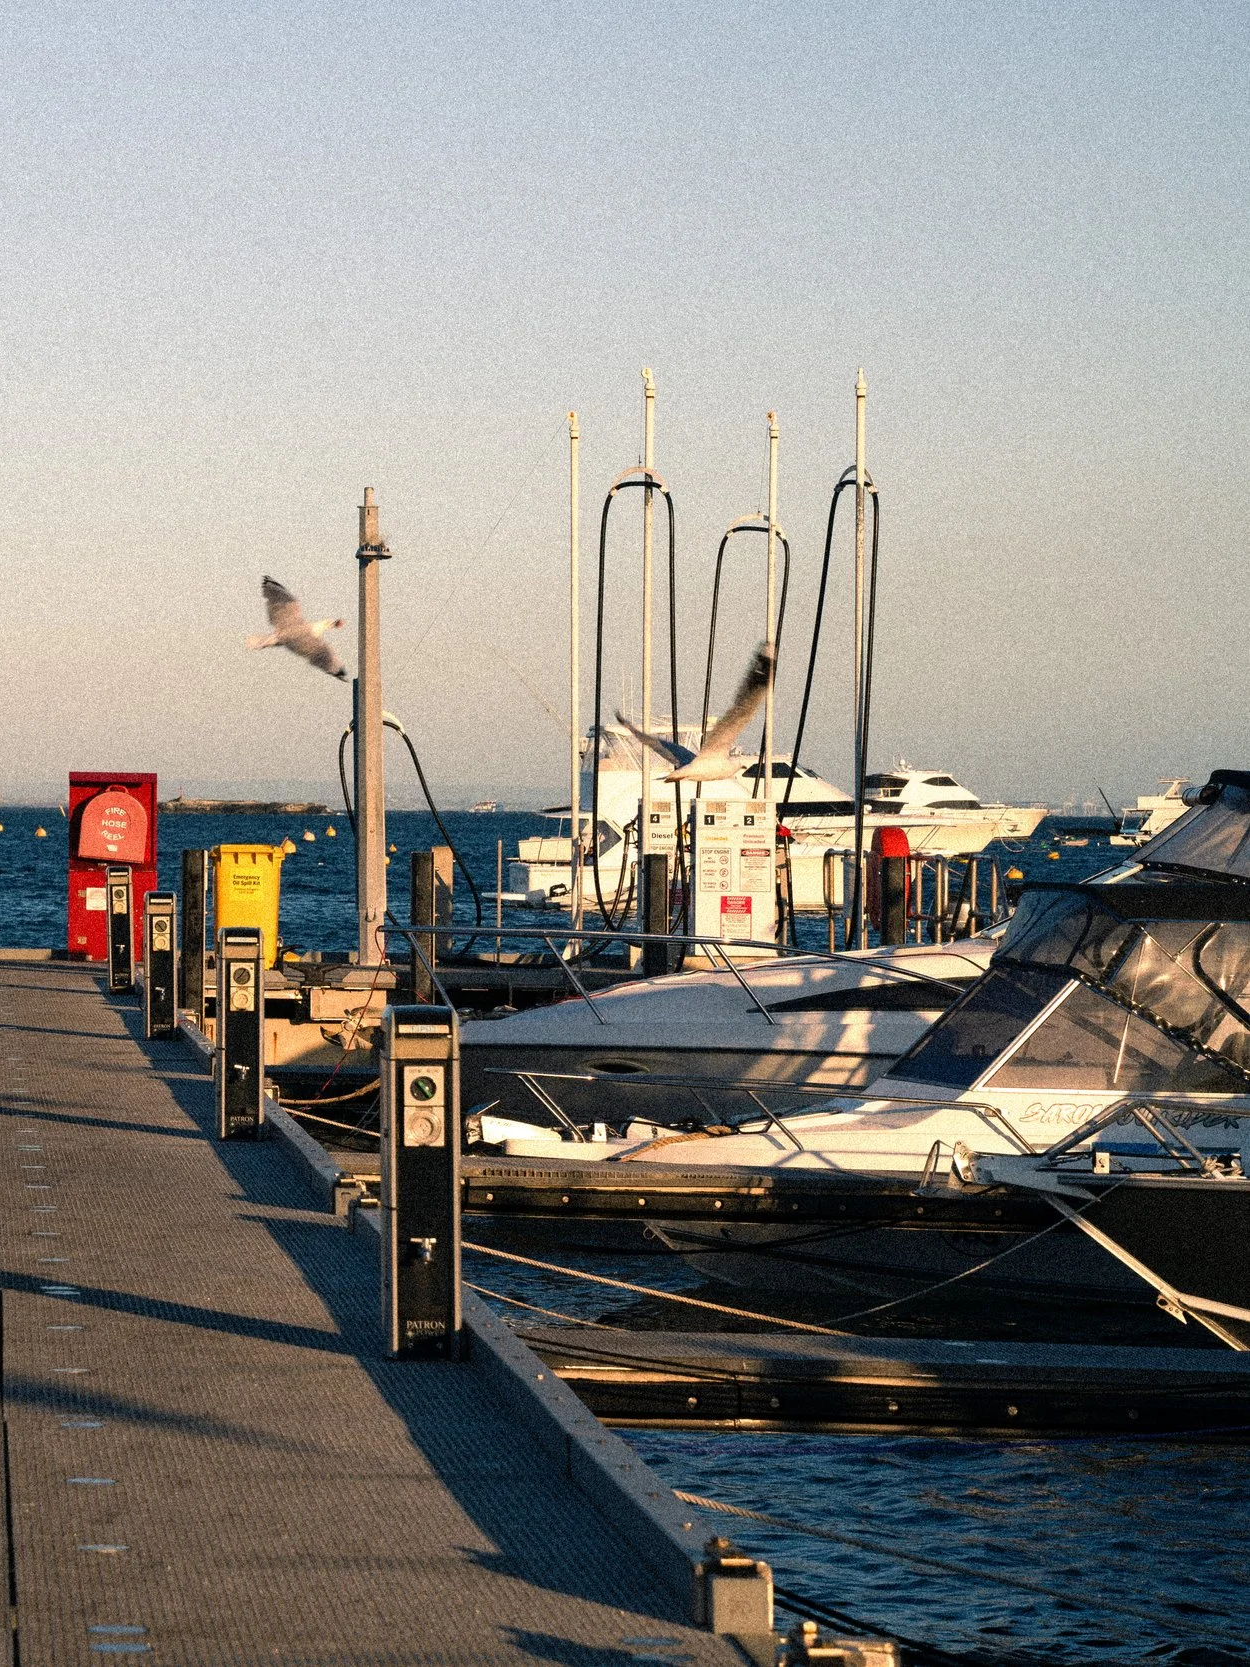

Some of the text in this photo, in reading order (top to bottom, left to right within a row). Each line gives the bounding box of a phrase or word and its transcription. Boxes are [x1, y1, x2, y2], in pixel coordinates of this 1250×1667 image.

[104, 807, 127, 817] FIRE
[101, 820, 127, 829] HOSE
[746, 817, 752, 825] 2
[101, 830, 125, 841] REEL
[233, 873, 261, 881] Emergency
[406, 1320, 446, 1330] PATRON
